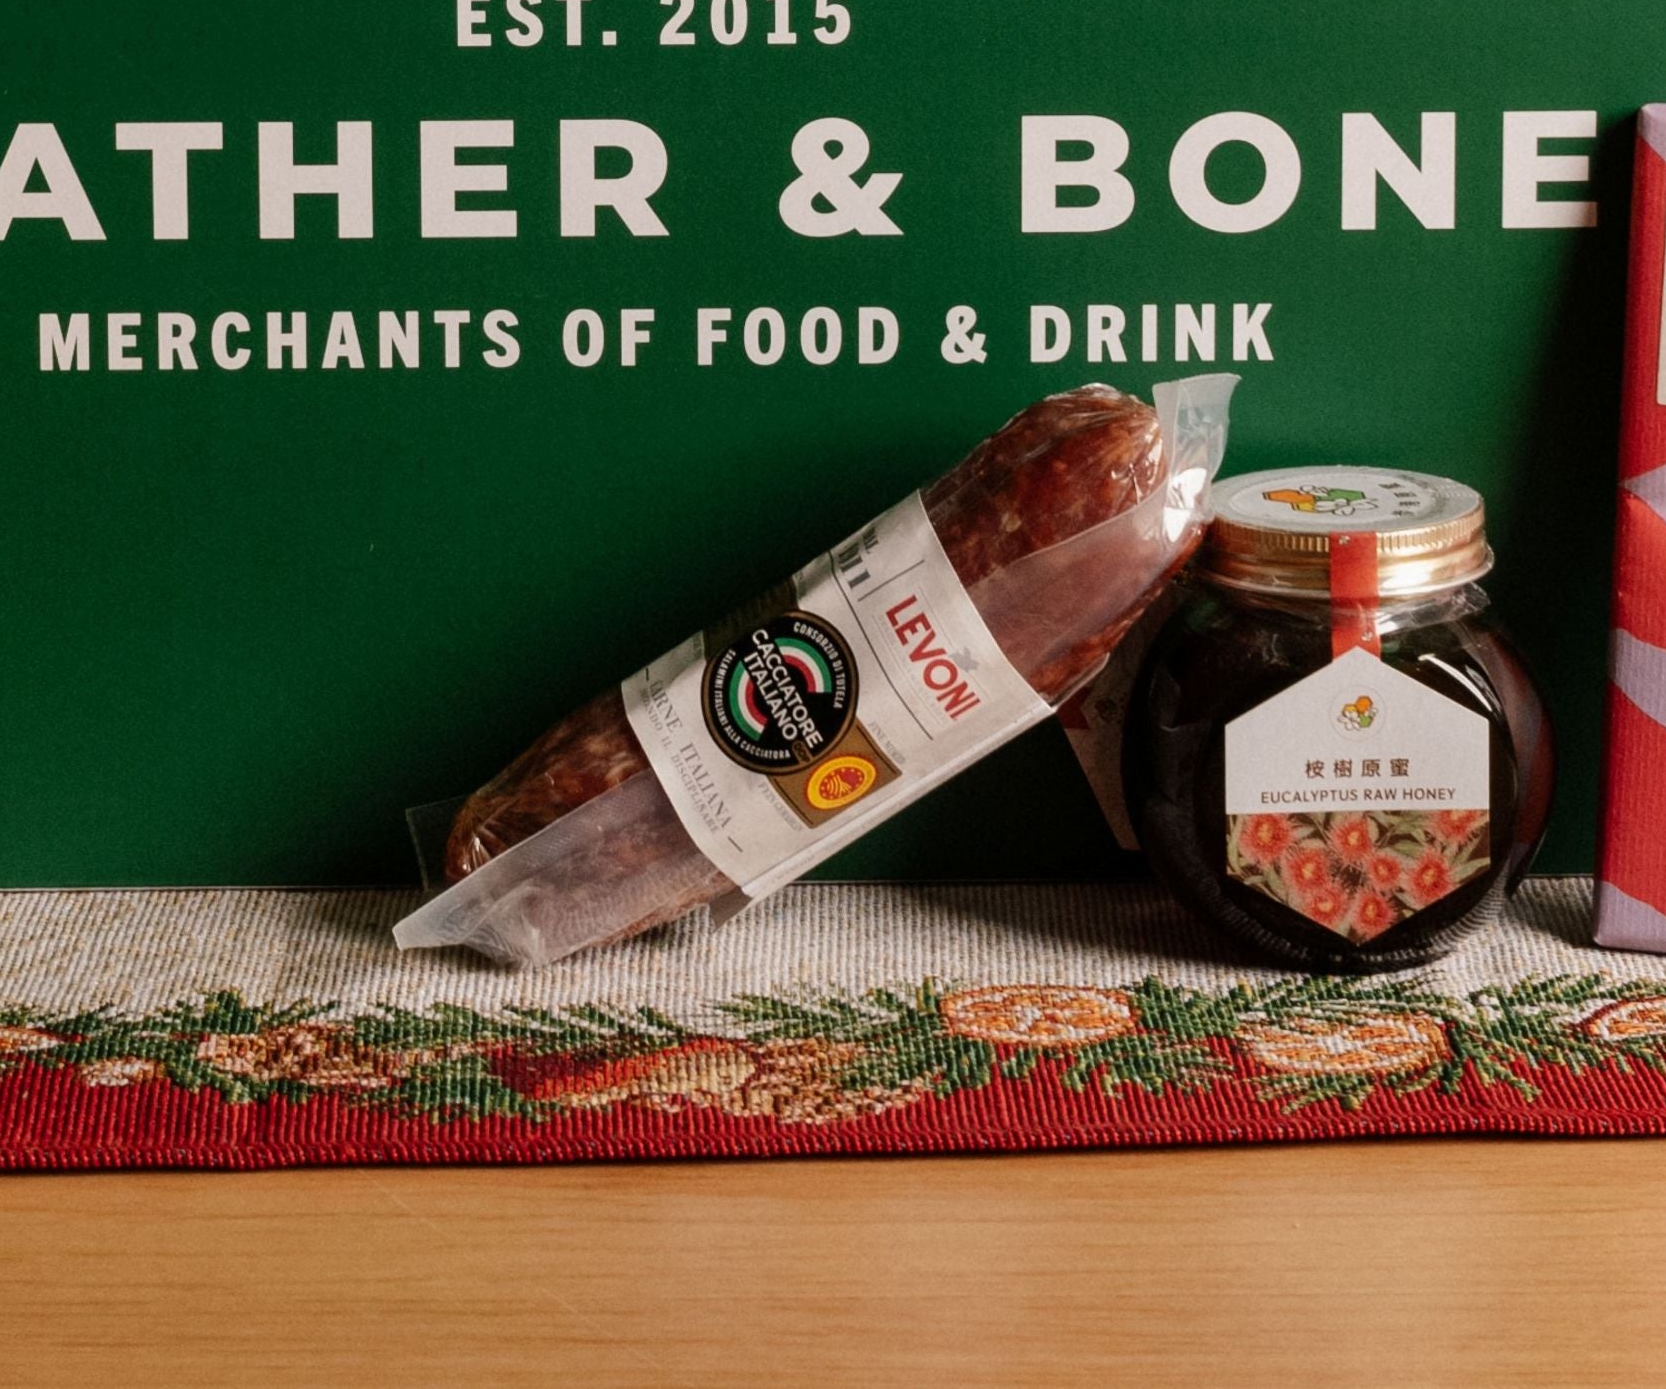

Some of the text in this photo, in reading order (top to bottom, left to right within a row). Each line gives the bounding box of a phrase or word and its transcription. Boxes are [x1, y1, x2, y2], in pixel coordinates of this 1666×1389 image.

[778, 117, 903, 237] &
[1021, 110, 1597, 233] BONE
[39, 302, 1273, 371] MERCHANTS OF FOOD & DRINK
[742, 650, 799, 742] ITALIANO
[751, 628, 824, 750] CACCIATORE
[885, 593, 982, 721] LEVONI
[1260, 786, 1457, 805] EUCALYPTUS RAW HONEY
